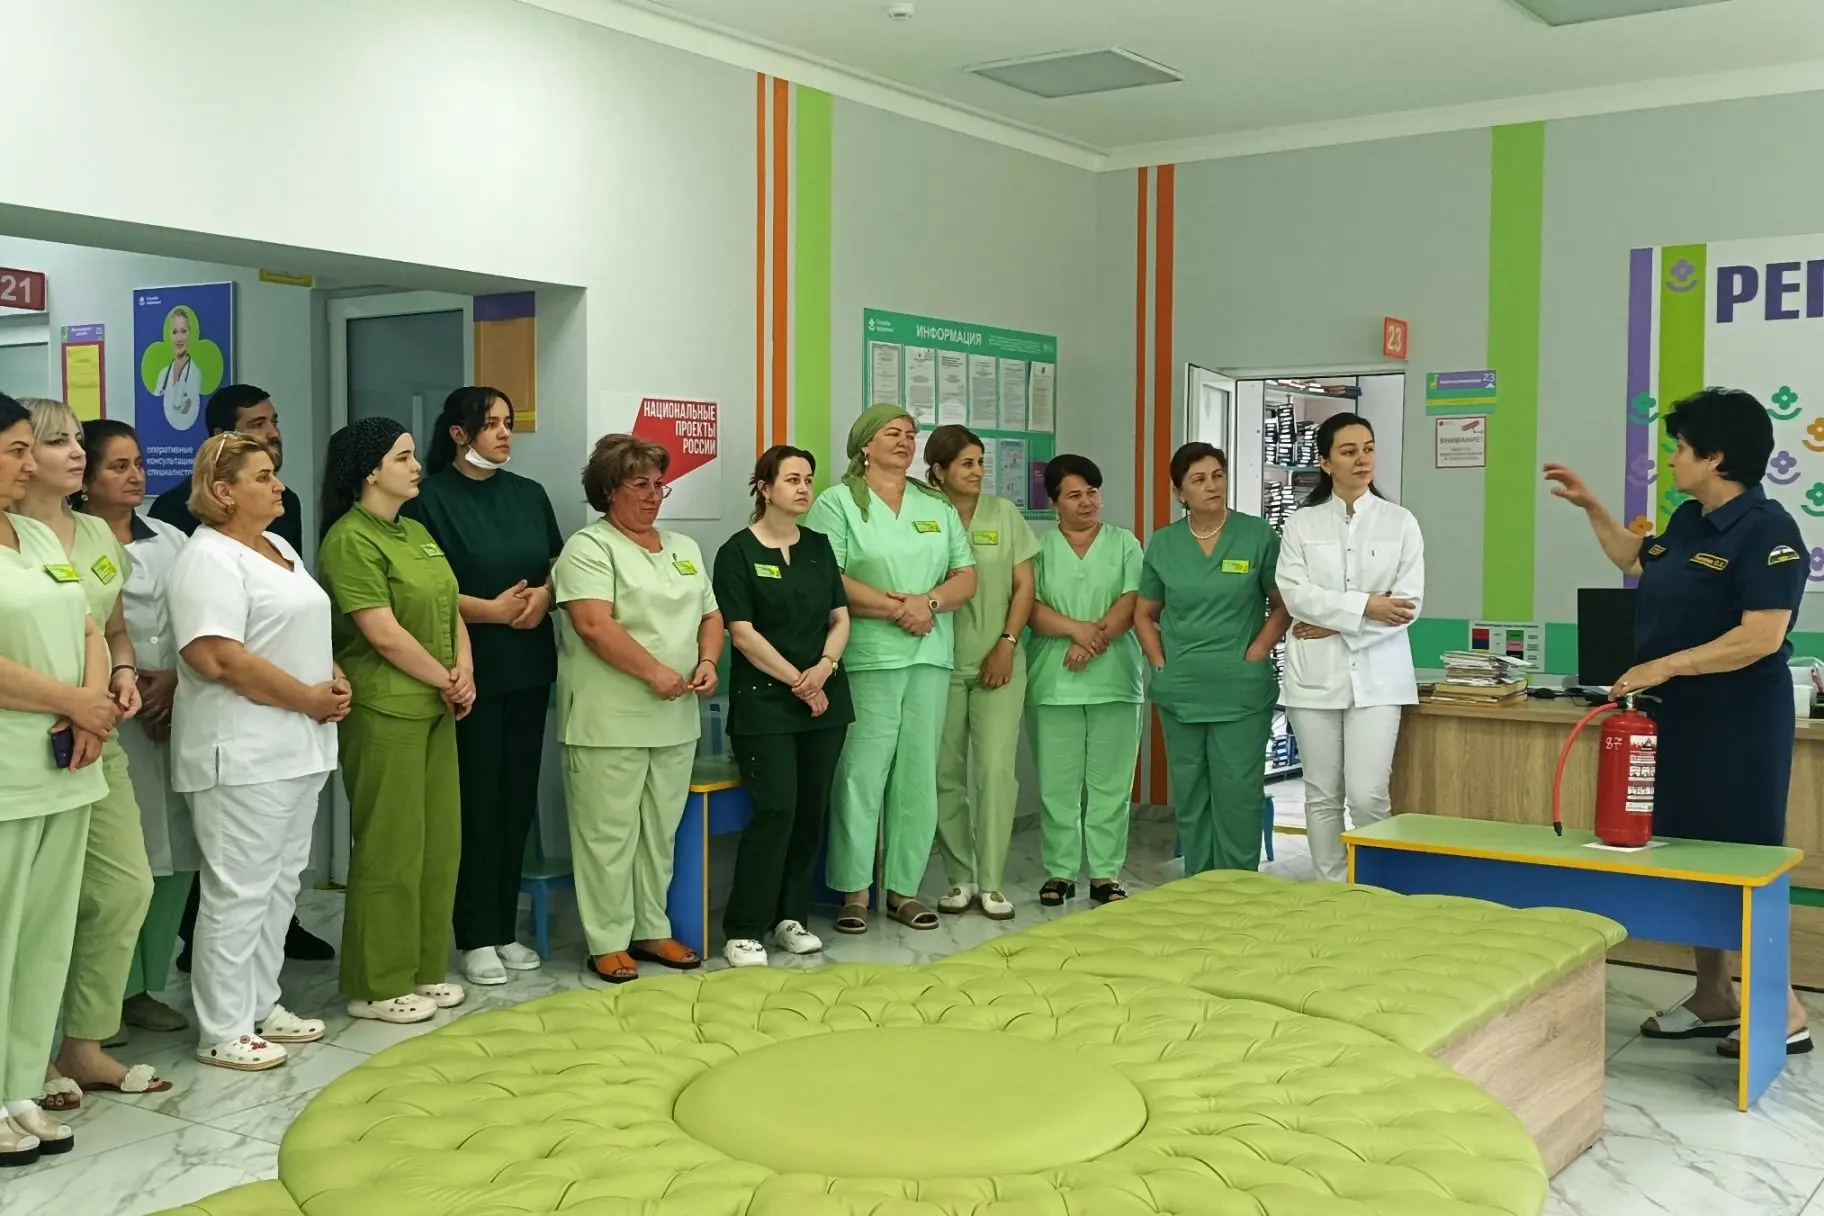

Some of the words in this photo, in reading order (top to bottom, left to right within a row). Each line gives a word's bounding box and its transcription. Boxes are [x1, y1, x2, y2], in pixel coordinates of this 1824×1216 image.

[0, 274, 31, 304] 21
[916, 324, 982, 346] ИНФОРМАЦИЯ
[1387, 325, 1402, 353] 23
[1483, 373, 1495, 382] 23
[643, 400, 716, 421] НАЦИОНАЛЬНЫЕ
[675, 420, 716, 438] ПРОЕКТЫ
[682, 438, 716, 455] РОССИИ
